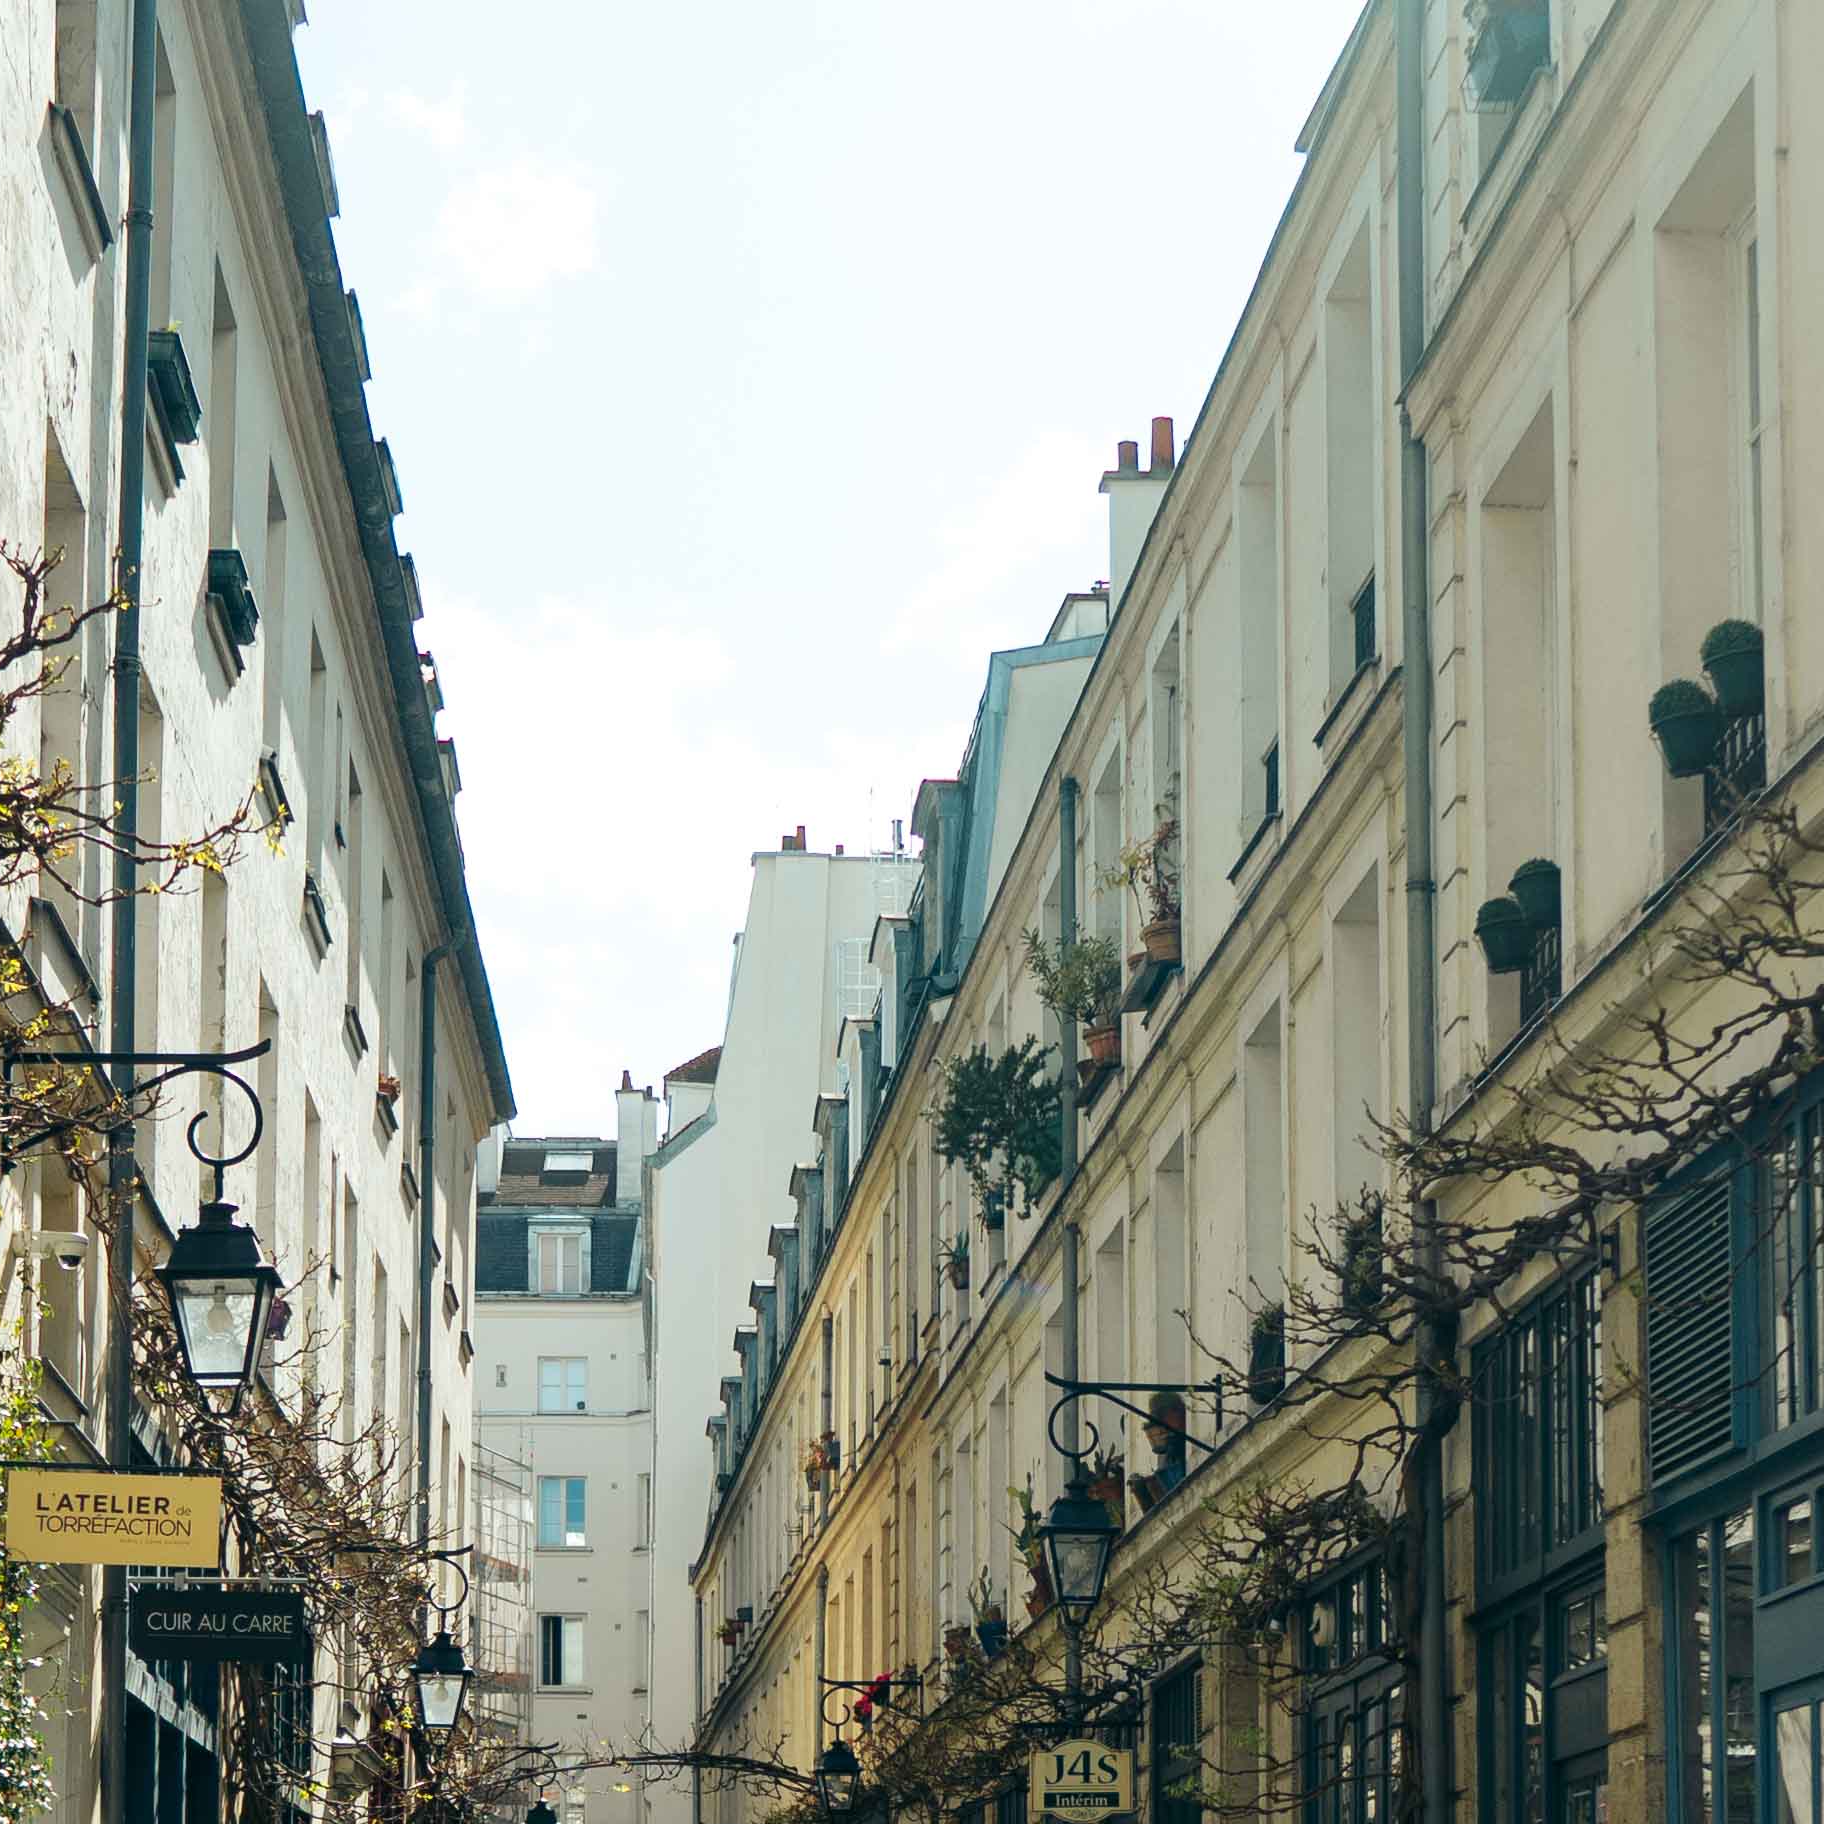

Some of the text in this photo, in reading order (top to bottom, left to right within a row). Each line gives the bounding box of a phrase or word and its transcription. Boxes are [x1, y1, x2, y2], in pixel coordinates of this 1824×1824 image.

[36, 1492, 192, 1517] L'ATELIER de
[146, 1611, 192, 1631] CUIR
[198, 1613, 226, 1632] AU
[1044, 1749, 1119, 1785] J4S
[1055, 1794, 1108, 1807] Intérim
